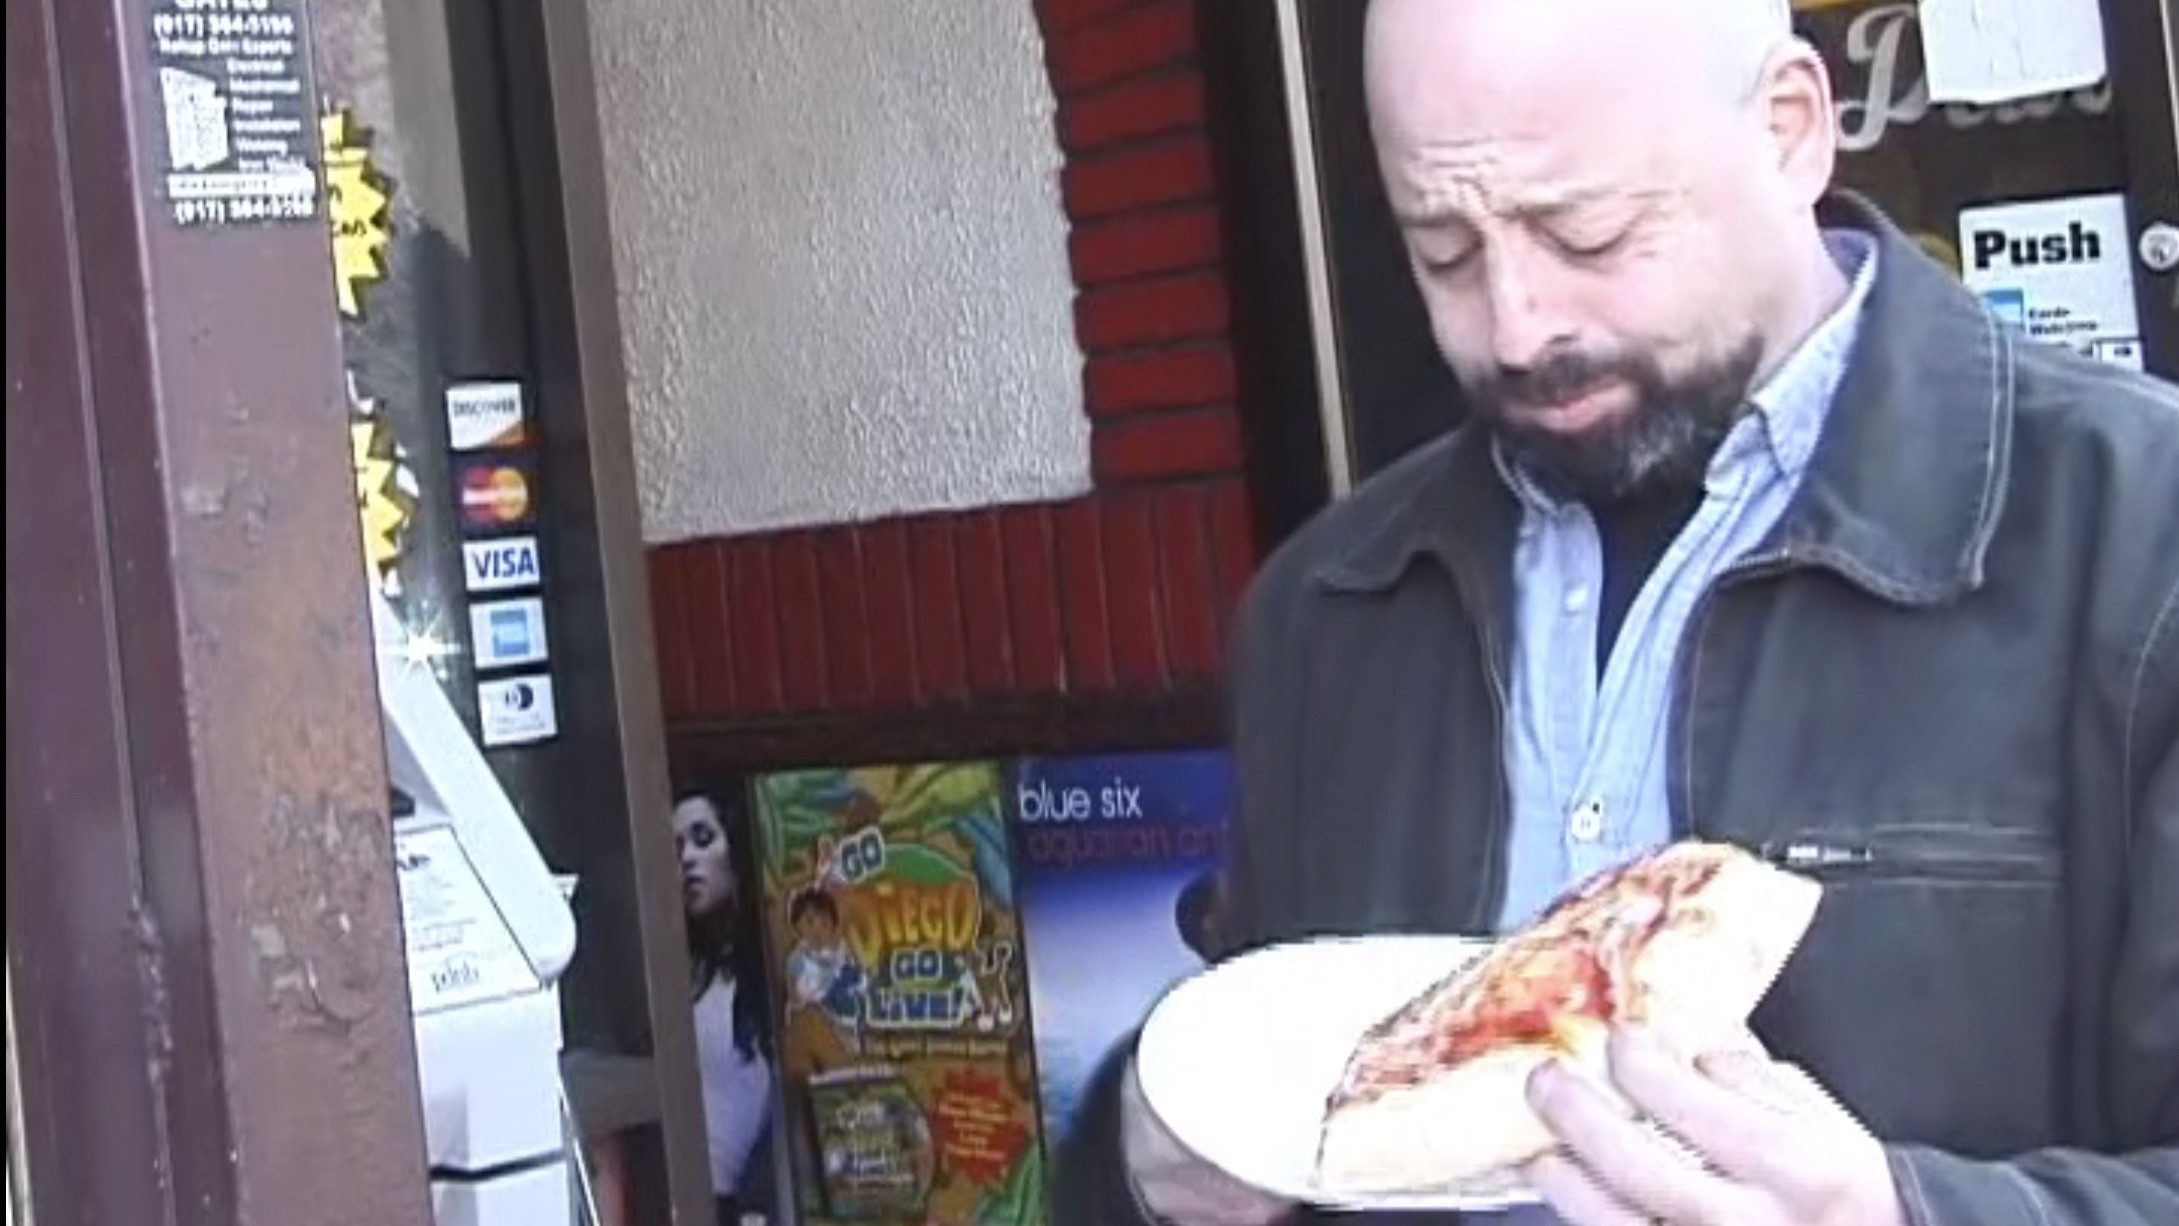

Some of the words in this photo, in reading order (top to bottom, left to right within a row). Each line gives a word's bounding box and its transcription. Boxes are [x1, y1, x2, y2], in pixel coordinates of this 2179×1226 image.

[1973, 221, 2101, 270] Push
[454, 398, 516, 418] DISCOVER
[472, 546, 536, 580] VISA
[1017, 779, 1091, 822] blue
[1100, 777, 1143, 819] six
[840, 829, 886, 884] GO
[891, 948, 943, 984] GO
